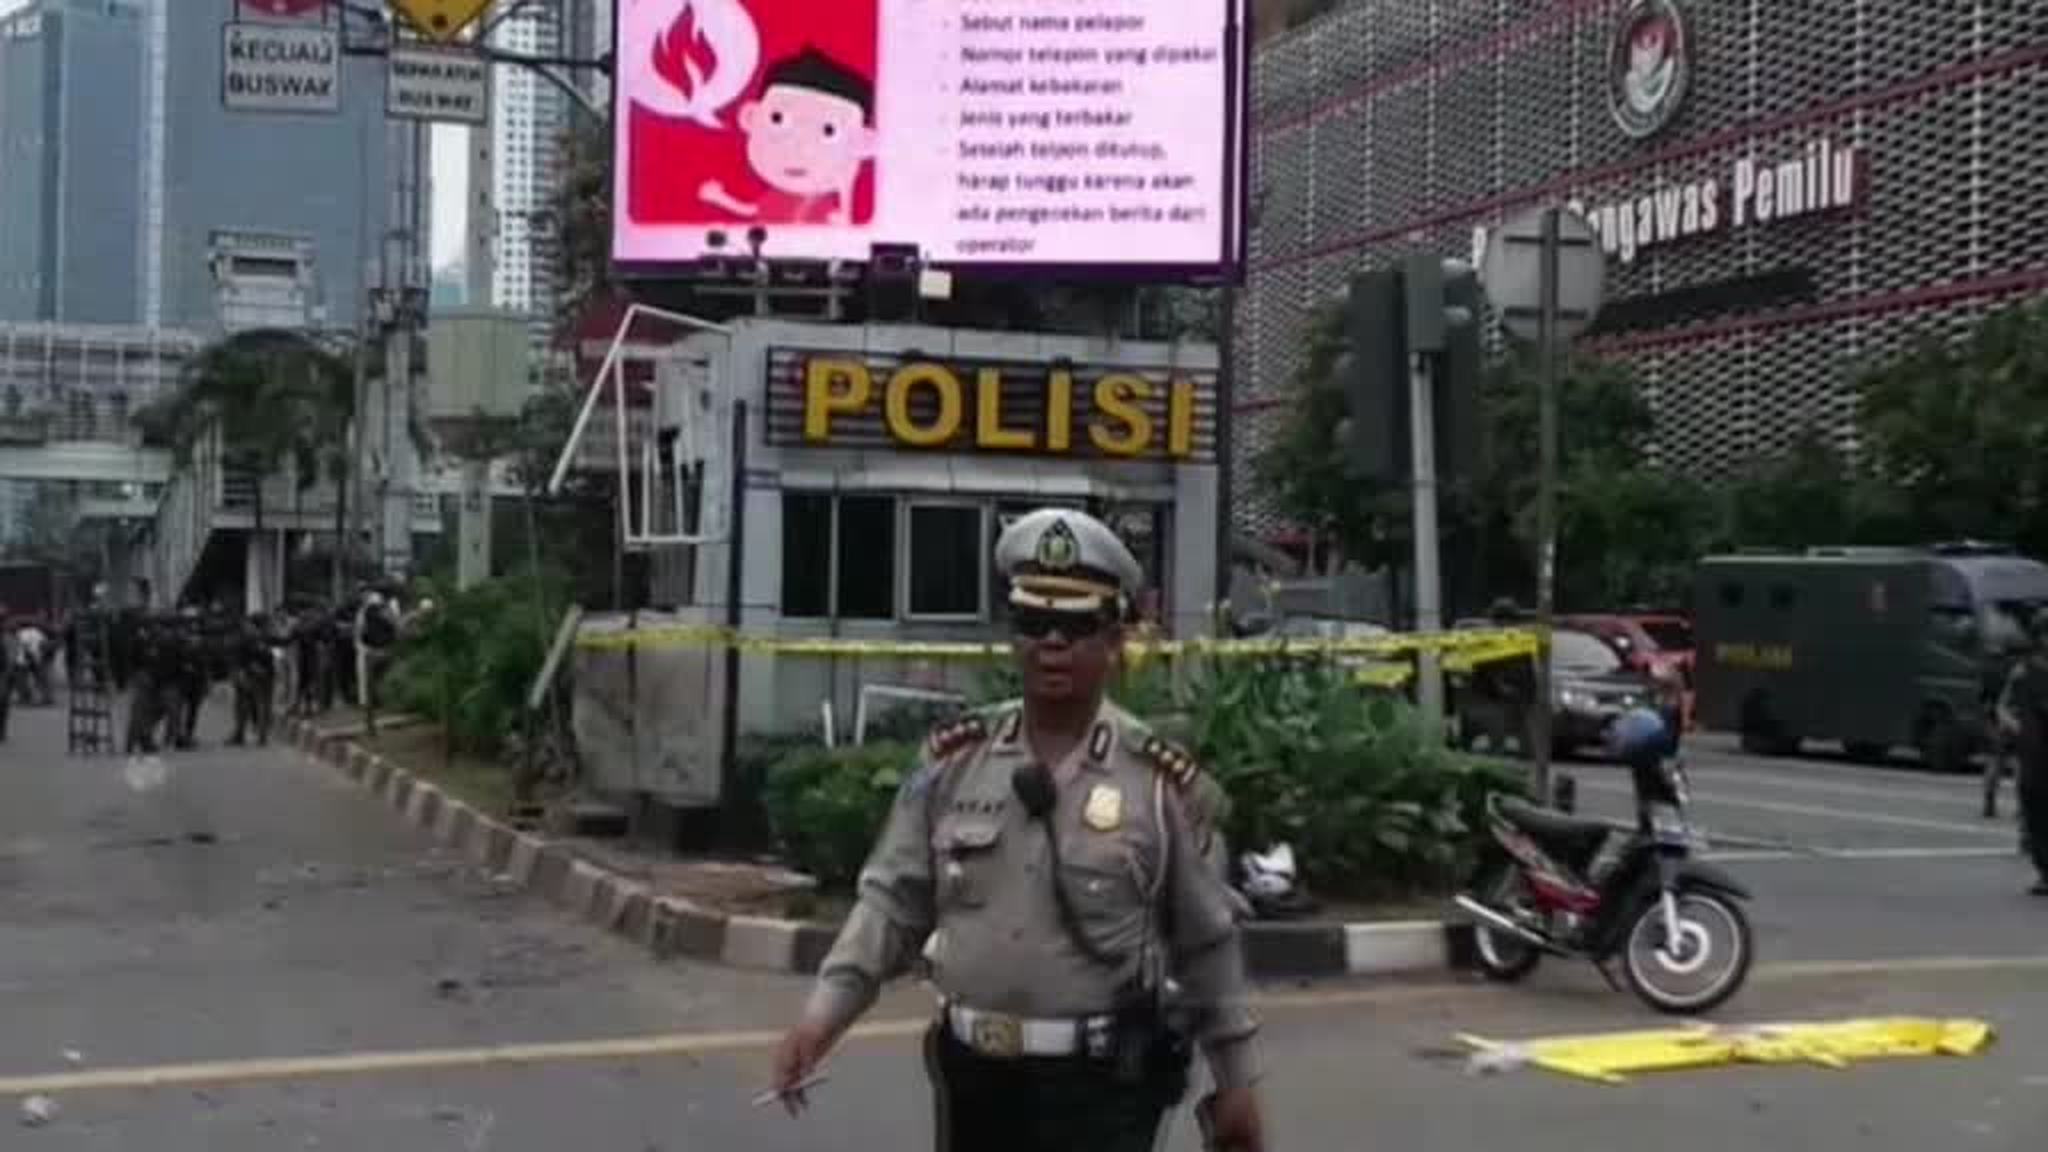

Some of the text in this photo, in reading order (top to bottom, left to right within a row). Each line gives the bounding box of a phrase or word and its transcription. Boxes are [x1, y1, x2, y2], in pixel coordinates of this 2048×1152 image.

[961, 14, 1144, 33] Sebut nama pelapor
[961, 47, 1022, 62] Nomor
[1029, 47, 1098, 64] telepon
[1104, 49, 1146, 65] yang
[960, 77, 1123, 93] Alamat kebakaran
[960, 108, 1132, 129] Jenis yang terbakar
[958, 172, 1194, 192] harap tunggu karena akan
[1733, 138, 1854, 227] Pemilu
[957, 206, 990, 221] ada
[1110, 204, 1163, 221] berita
[803, 357, 1193, 456] POLISI
